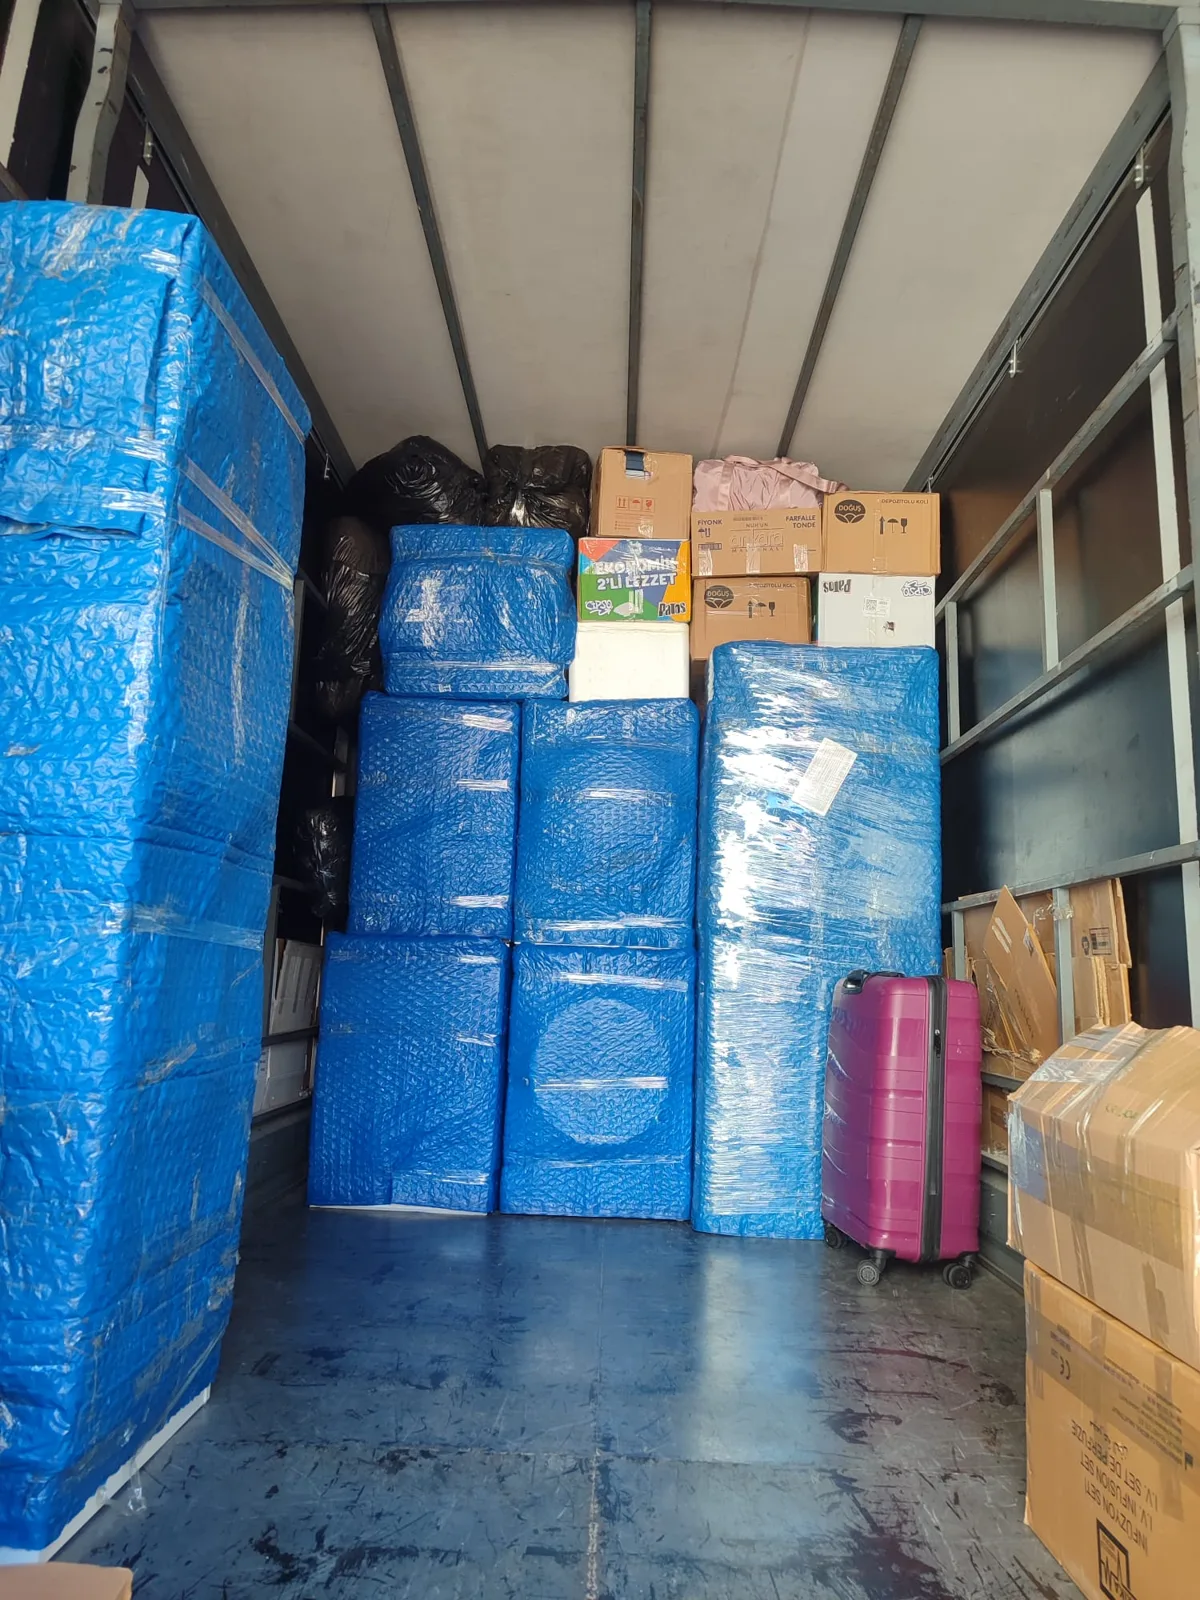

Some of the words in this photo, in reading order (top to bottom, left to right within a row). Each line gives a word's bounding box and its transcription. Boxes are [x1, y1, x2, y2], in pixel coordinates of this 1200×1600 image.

[838, 504, 862, 512] DOĞUŞ
[625, 573, 677, 588] LEZZET
[1080, 1450, 1095, 1475] SET
[1109, 1453, 1122, 1479] DE
[1096, 1465, 1137, 1514] INFUSION
[1124, 1470, 1141, 1496] SET
